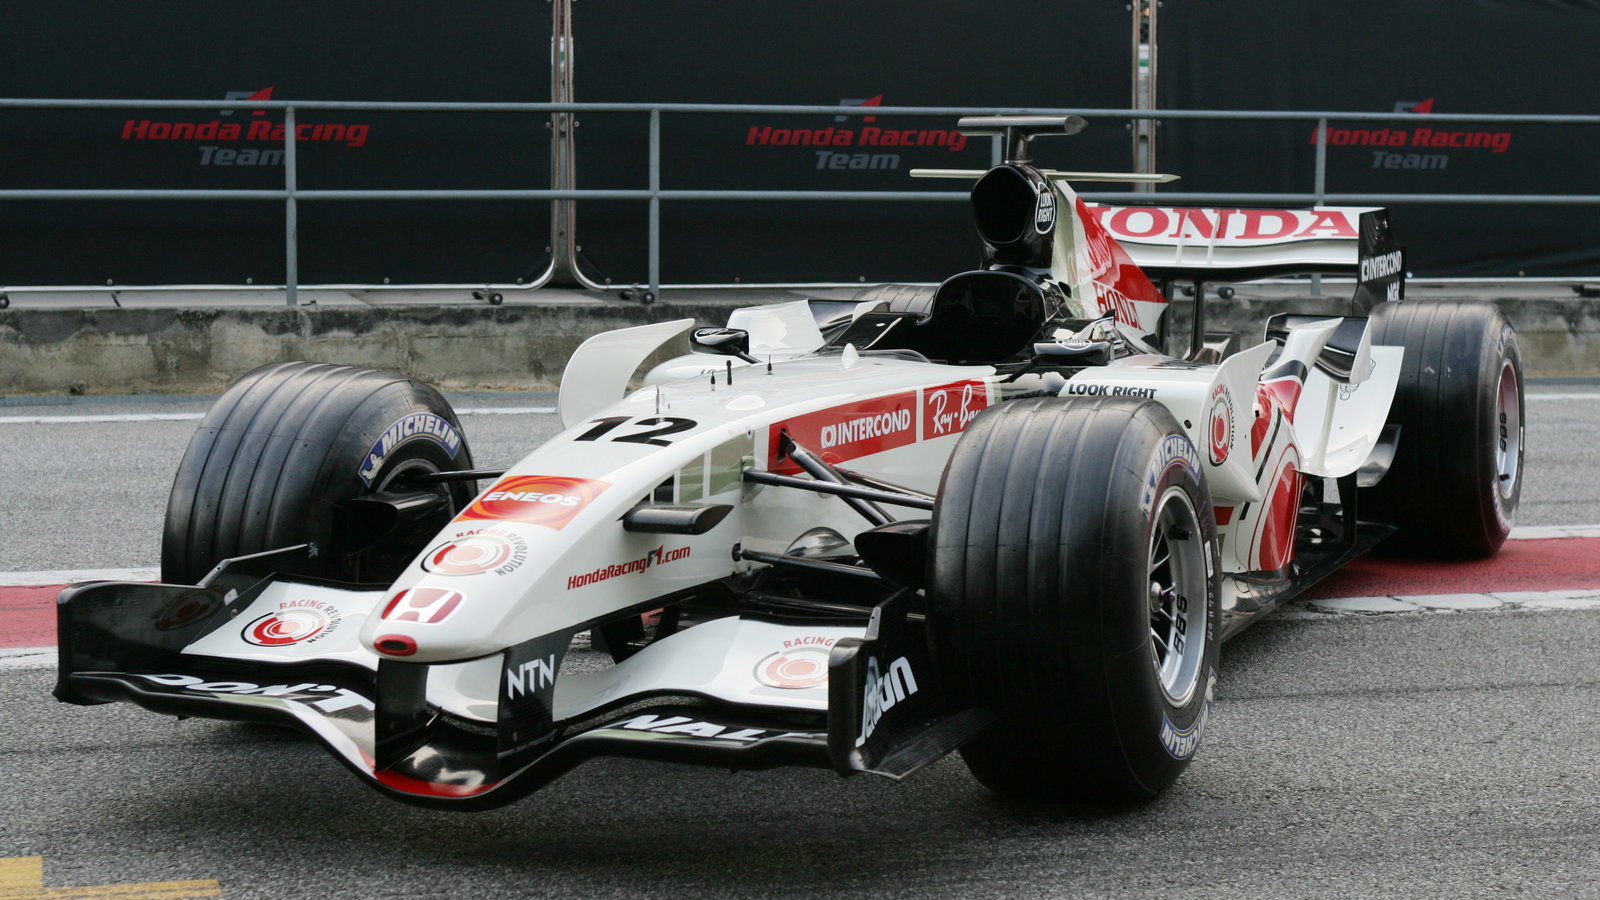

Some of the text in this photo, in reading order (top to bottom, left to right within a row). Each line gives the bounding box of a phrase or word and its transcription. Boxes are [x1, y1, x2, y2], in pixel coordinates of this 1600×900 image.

[121, 119, 370, 147] Honda Racing
[746, 126, 968, 151] Honda Racing
[1411, 128, 1512, 153] Racing
[200, 146, 288, 166] Team
[815, 151, 900, 170] Team
[1372, 151, 1449, 170] Team
[1040, 192, 1053, 207] LOOK
[1037, 207, 1053, 222] RIGHT
[1369, 250, 1402, 281] INTERCOND
[1068, 383, 1158, 400] LOOK RIGHT
[381, 415, 460, 455] MICHELIN
[574, 416, 698, 448] 12
[837, 409, 911, 446] INTERCOND
[1151, 438, 1200, 483] MICHELIN
[482, 491, 582, 508] ENEOS
[456, 528, 528, 576] RACING REVOLUTION
[567, 545, 691, 590] HondaRacingF1.com
[280, 599, 342, 644] RACING REVOLUTION
[1174, 594, 1188, 655] BBS
[783, 636, 835, 648] RACING
[507, 654, 555, 700] NTN
